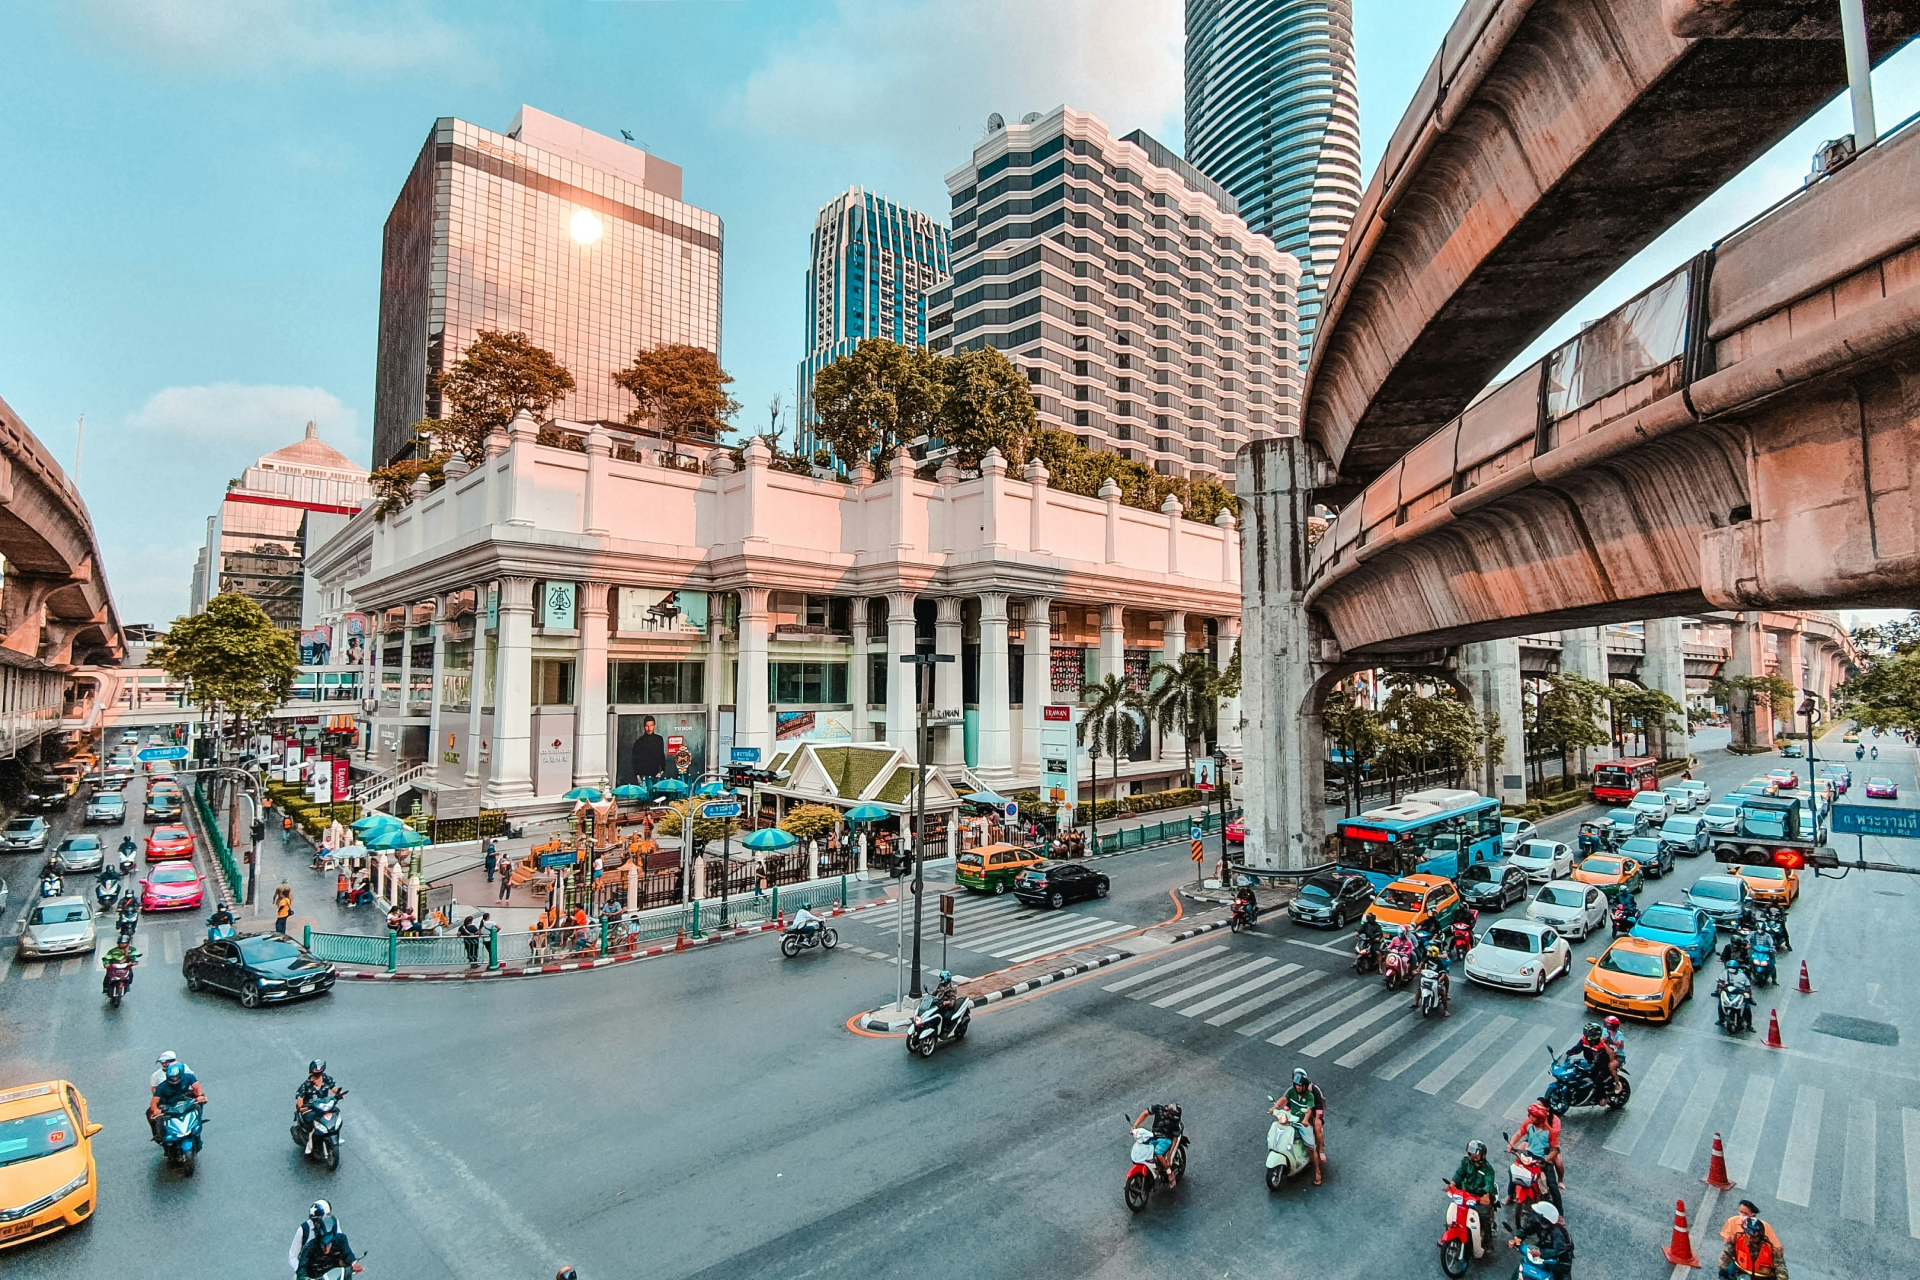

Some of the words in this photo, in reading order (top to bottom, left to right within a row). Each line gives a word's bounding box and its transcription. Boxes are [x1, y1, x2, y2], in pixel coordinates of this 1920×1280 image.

[1045, 709, 1067, 717] ERAWAN
[338, 767, 346, 794] ERAWAN
[1843, 815, 1853, 824] ถ.
[1856, 812, 1917, 829] พระรามที่
[1861, 826, 1887, 834] Rama
